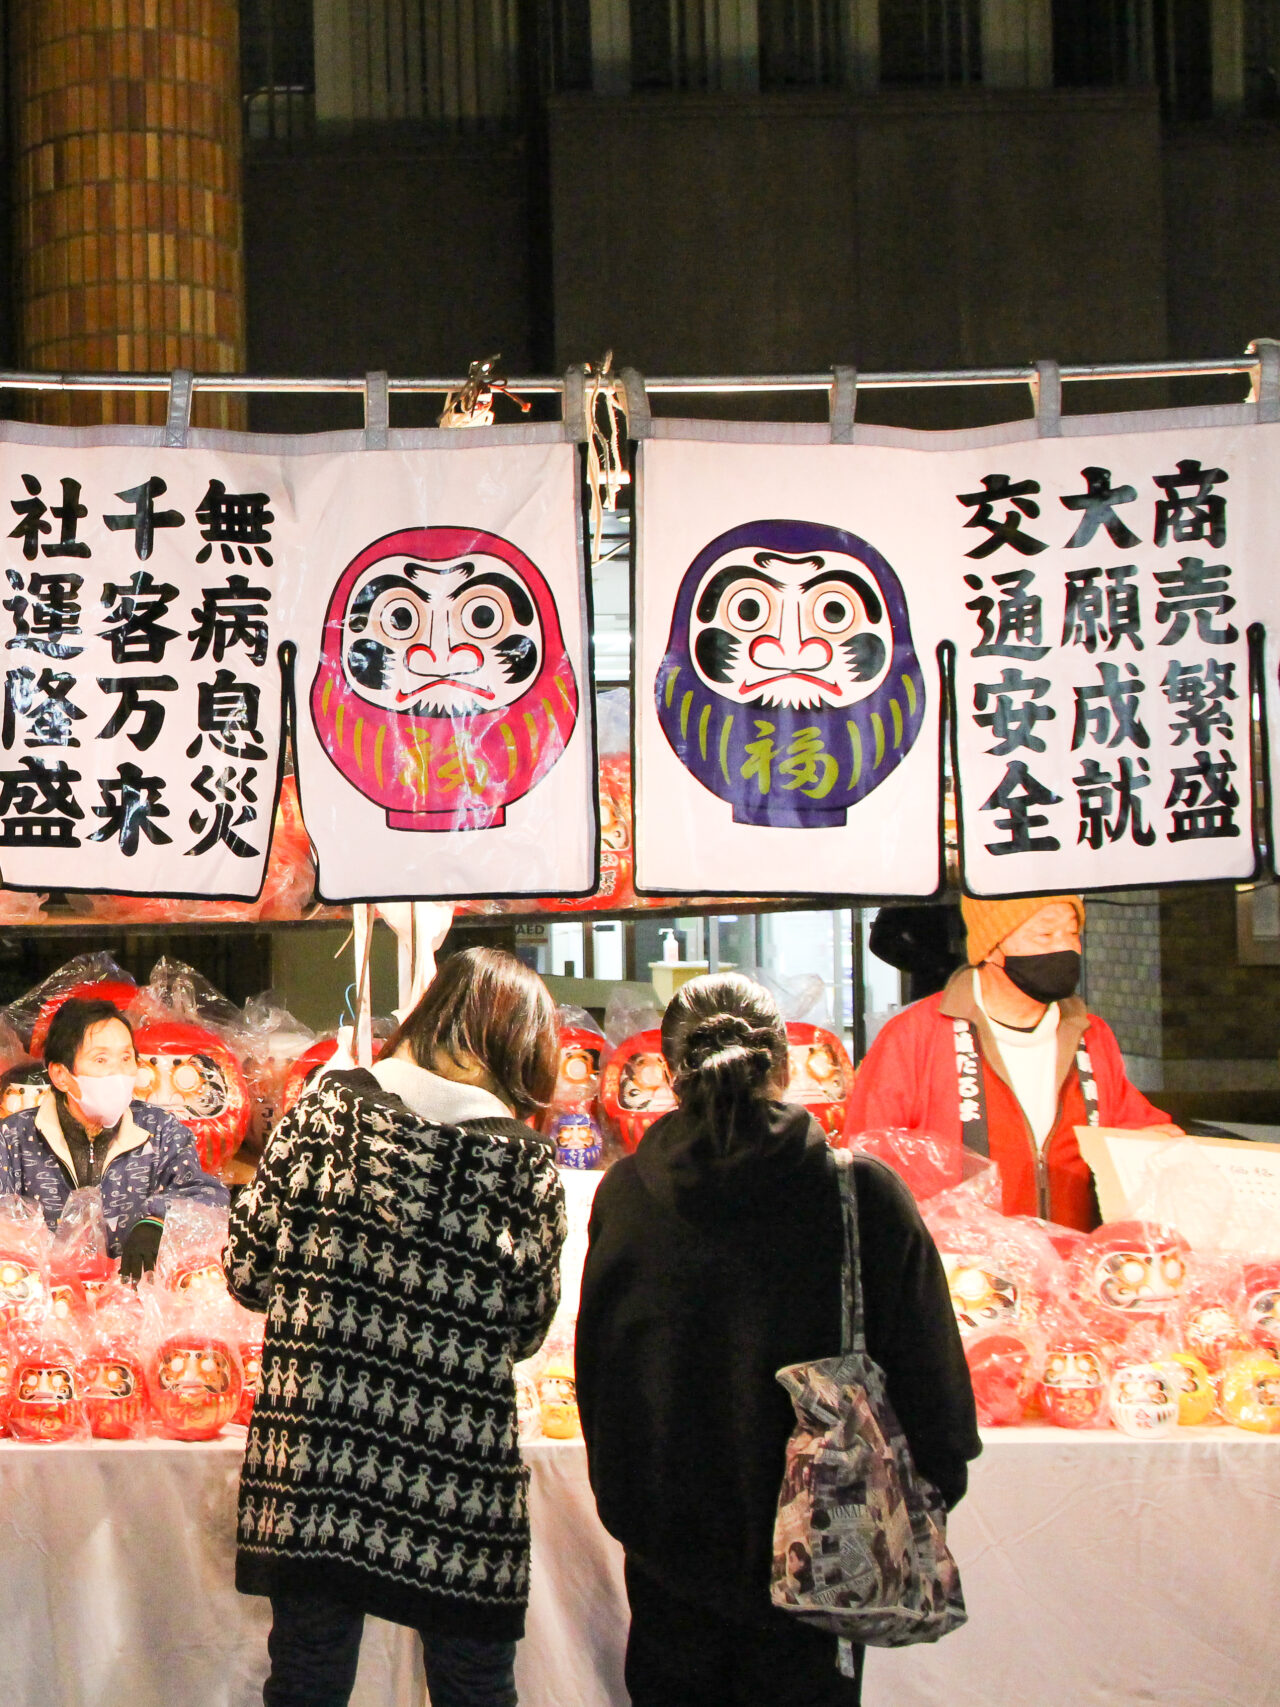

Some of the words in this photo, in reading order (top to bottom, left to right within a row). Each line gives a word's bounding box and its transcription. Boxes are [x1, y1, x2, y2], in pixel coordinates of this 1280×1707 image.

[86, 476, 186, 857] 千客万来
[182, 478, 276, 858] 無病息災
[740, 720, 840, 800] 福
[956, 473, 1064, 856] 交通安全
[1059, 466, 1157, 850] 大願成就
[1152, 459, 1241, 844] 商売繁盛
